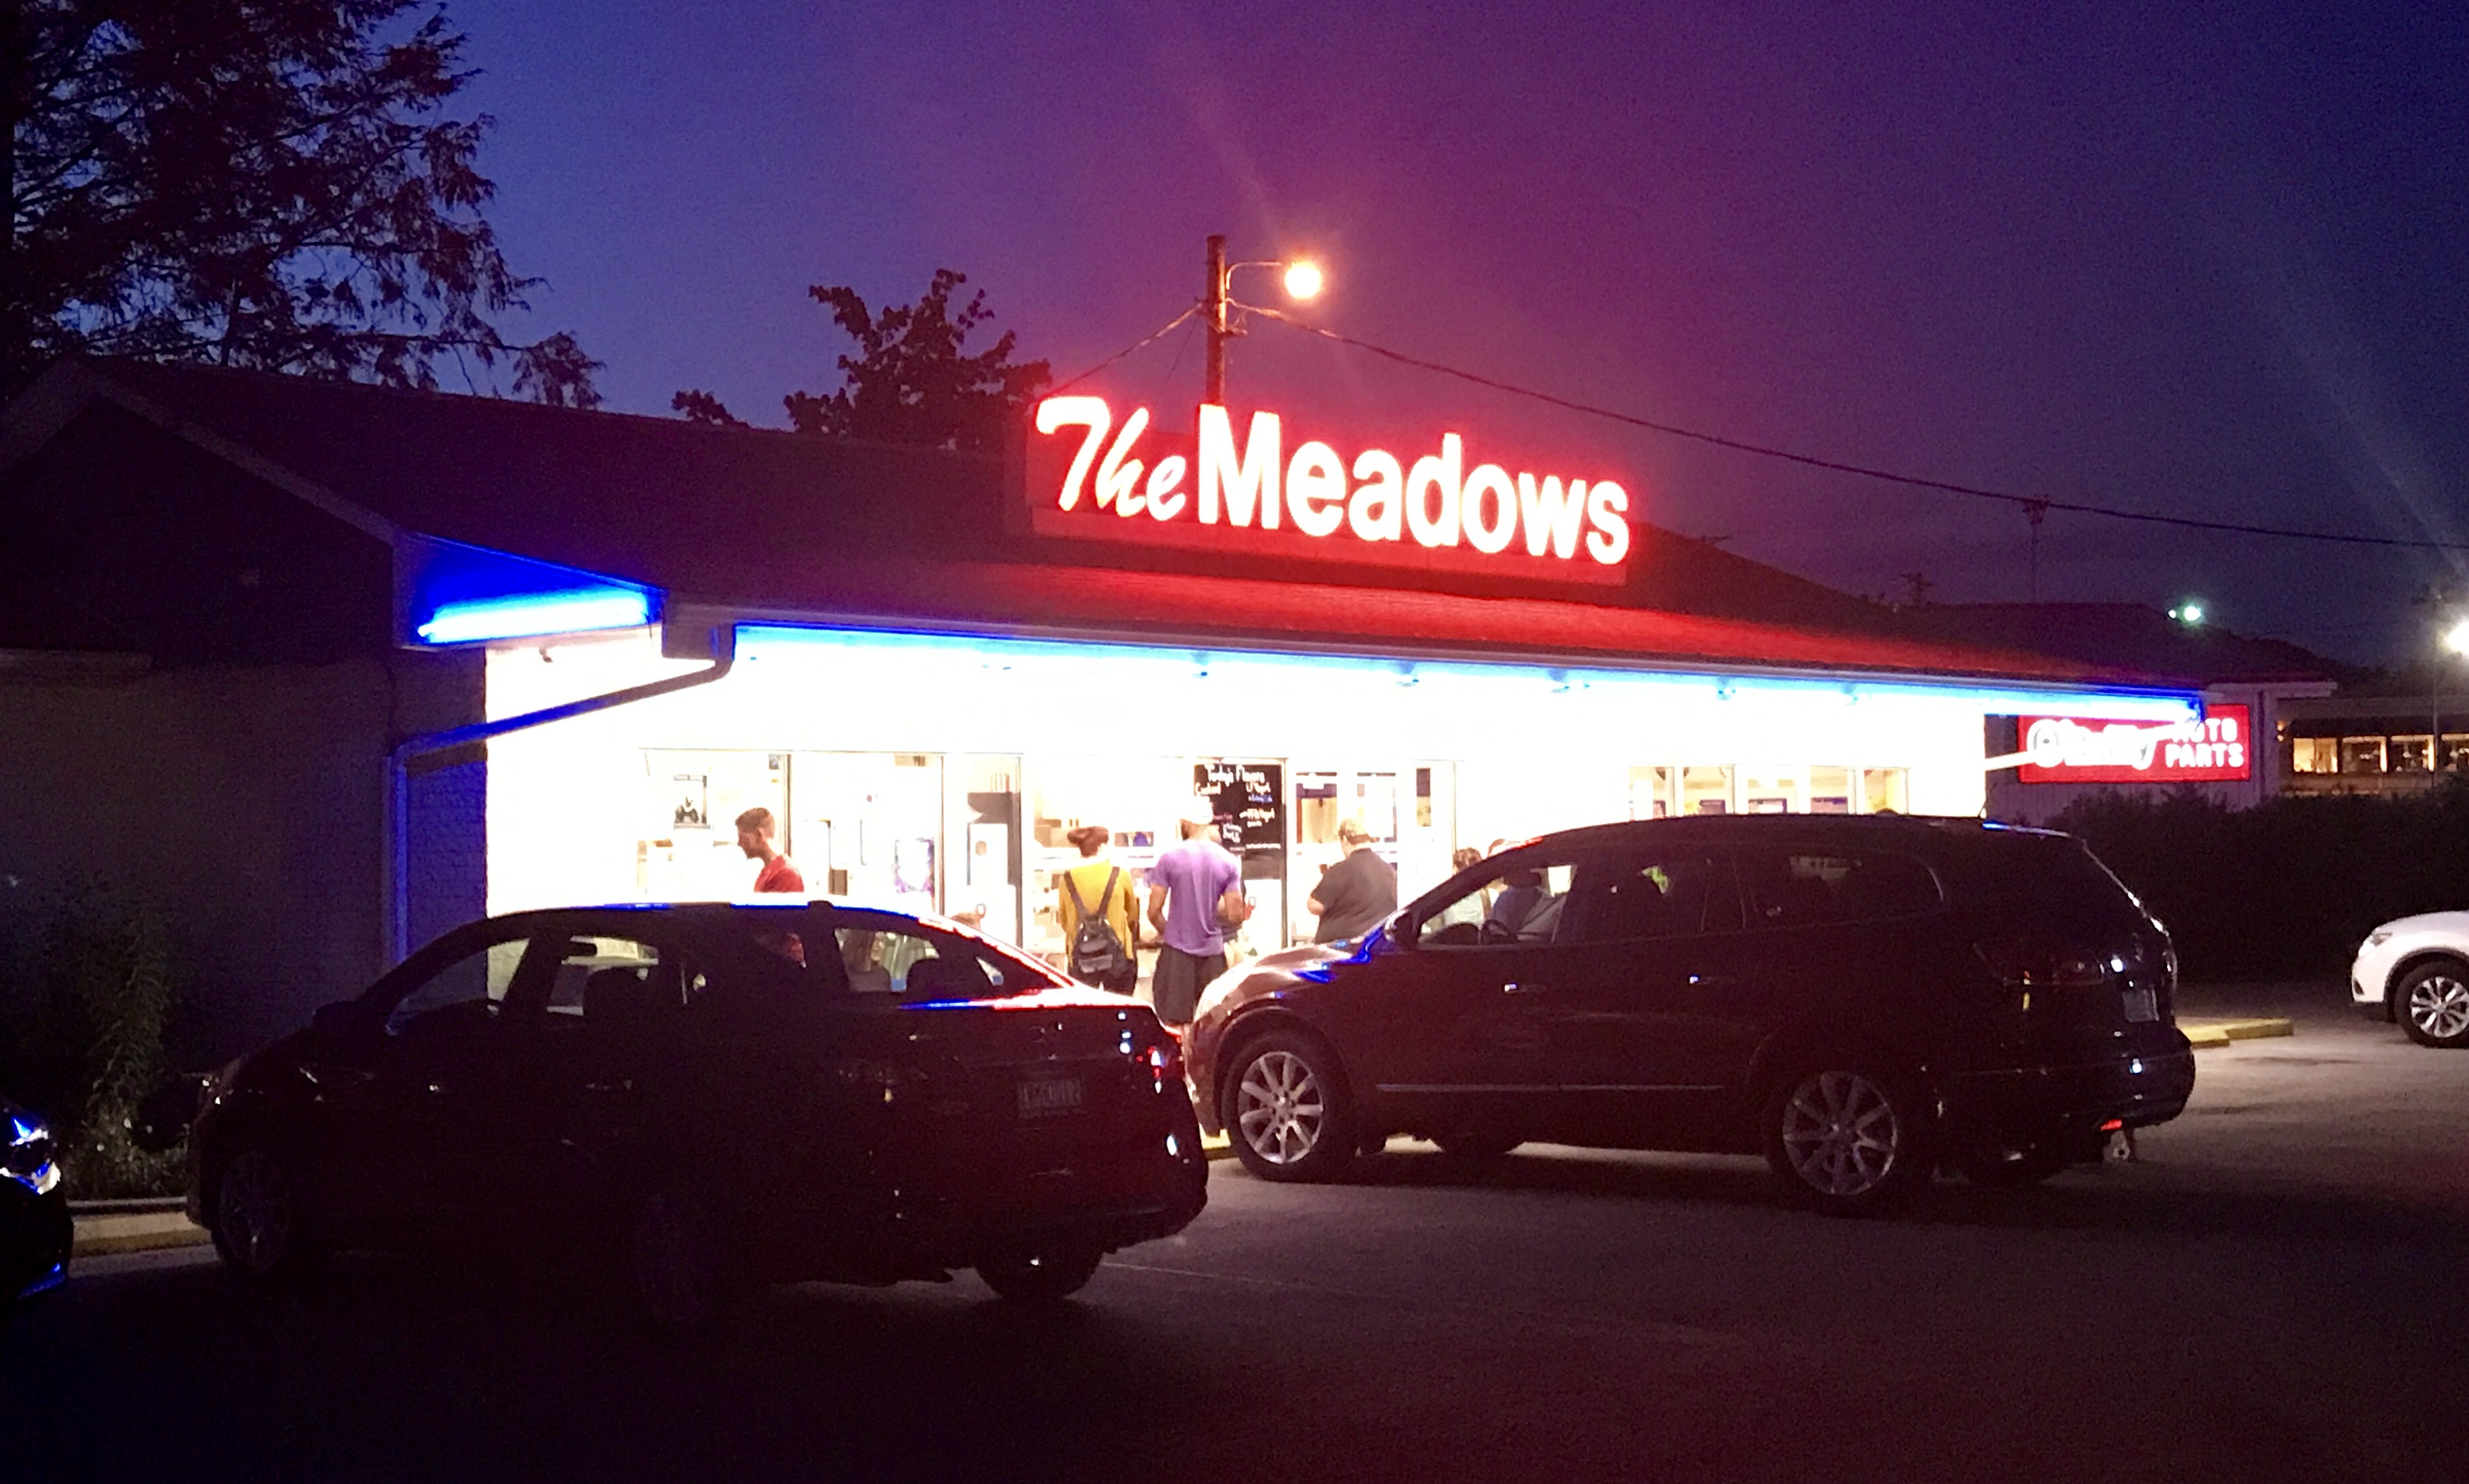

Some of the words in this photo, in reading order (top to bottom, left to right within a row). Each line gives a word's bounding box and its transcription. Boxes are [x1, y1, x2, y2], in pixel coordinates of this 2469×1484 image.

[1036, 396, 1188, 522] The
[1197, 403, 1629, 566] Meadows
[2165, 742, 2244, 768] PARTS
